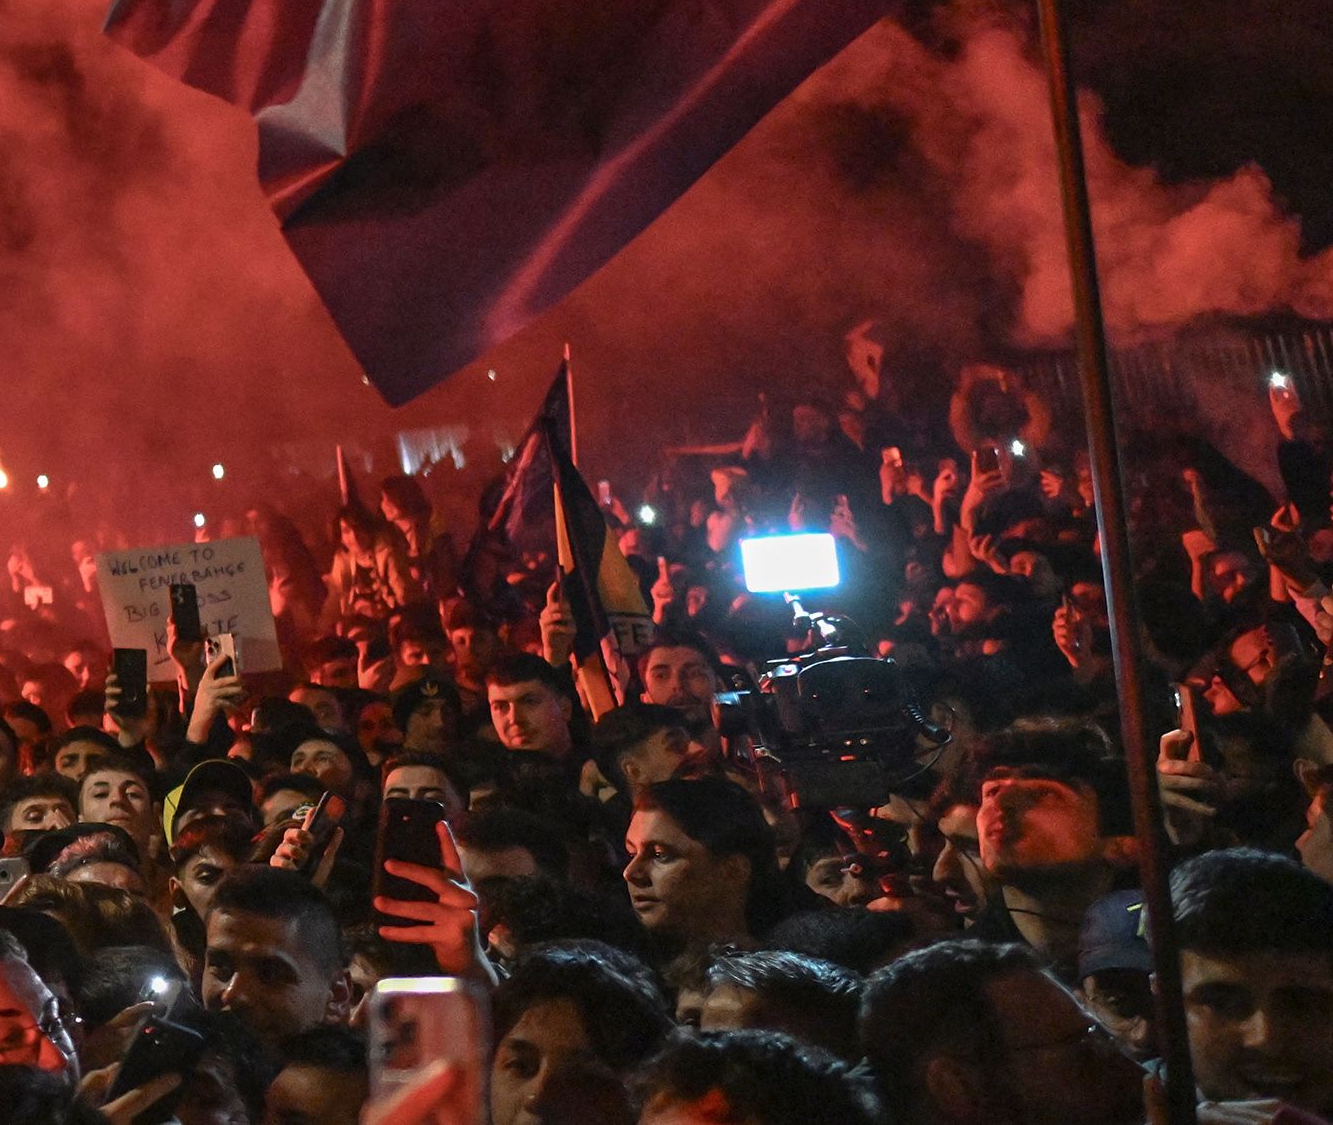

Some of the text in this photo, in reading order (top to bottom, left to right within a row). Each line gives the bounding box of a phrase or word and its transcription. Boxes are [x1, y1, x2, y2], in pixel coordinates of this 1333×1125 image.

[108, 548, 214, 576] WELCOME TO
[124, 590, 231, 623] BIG OSS
